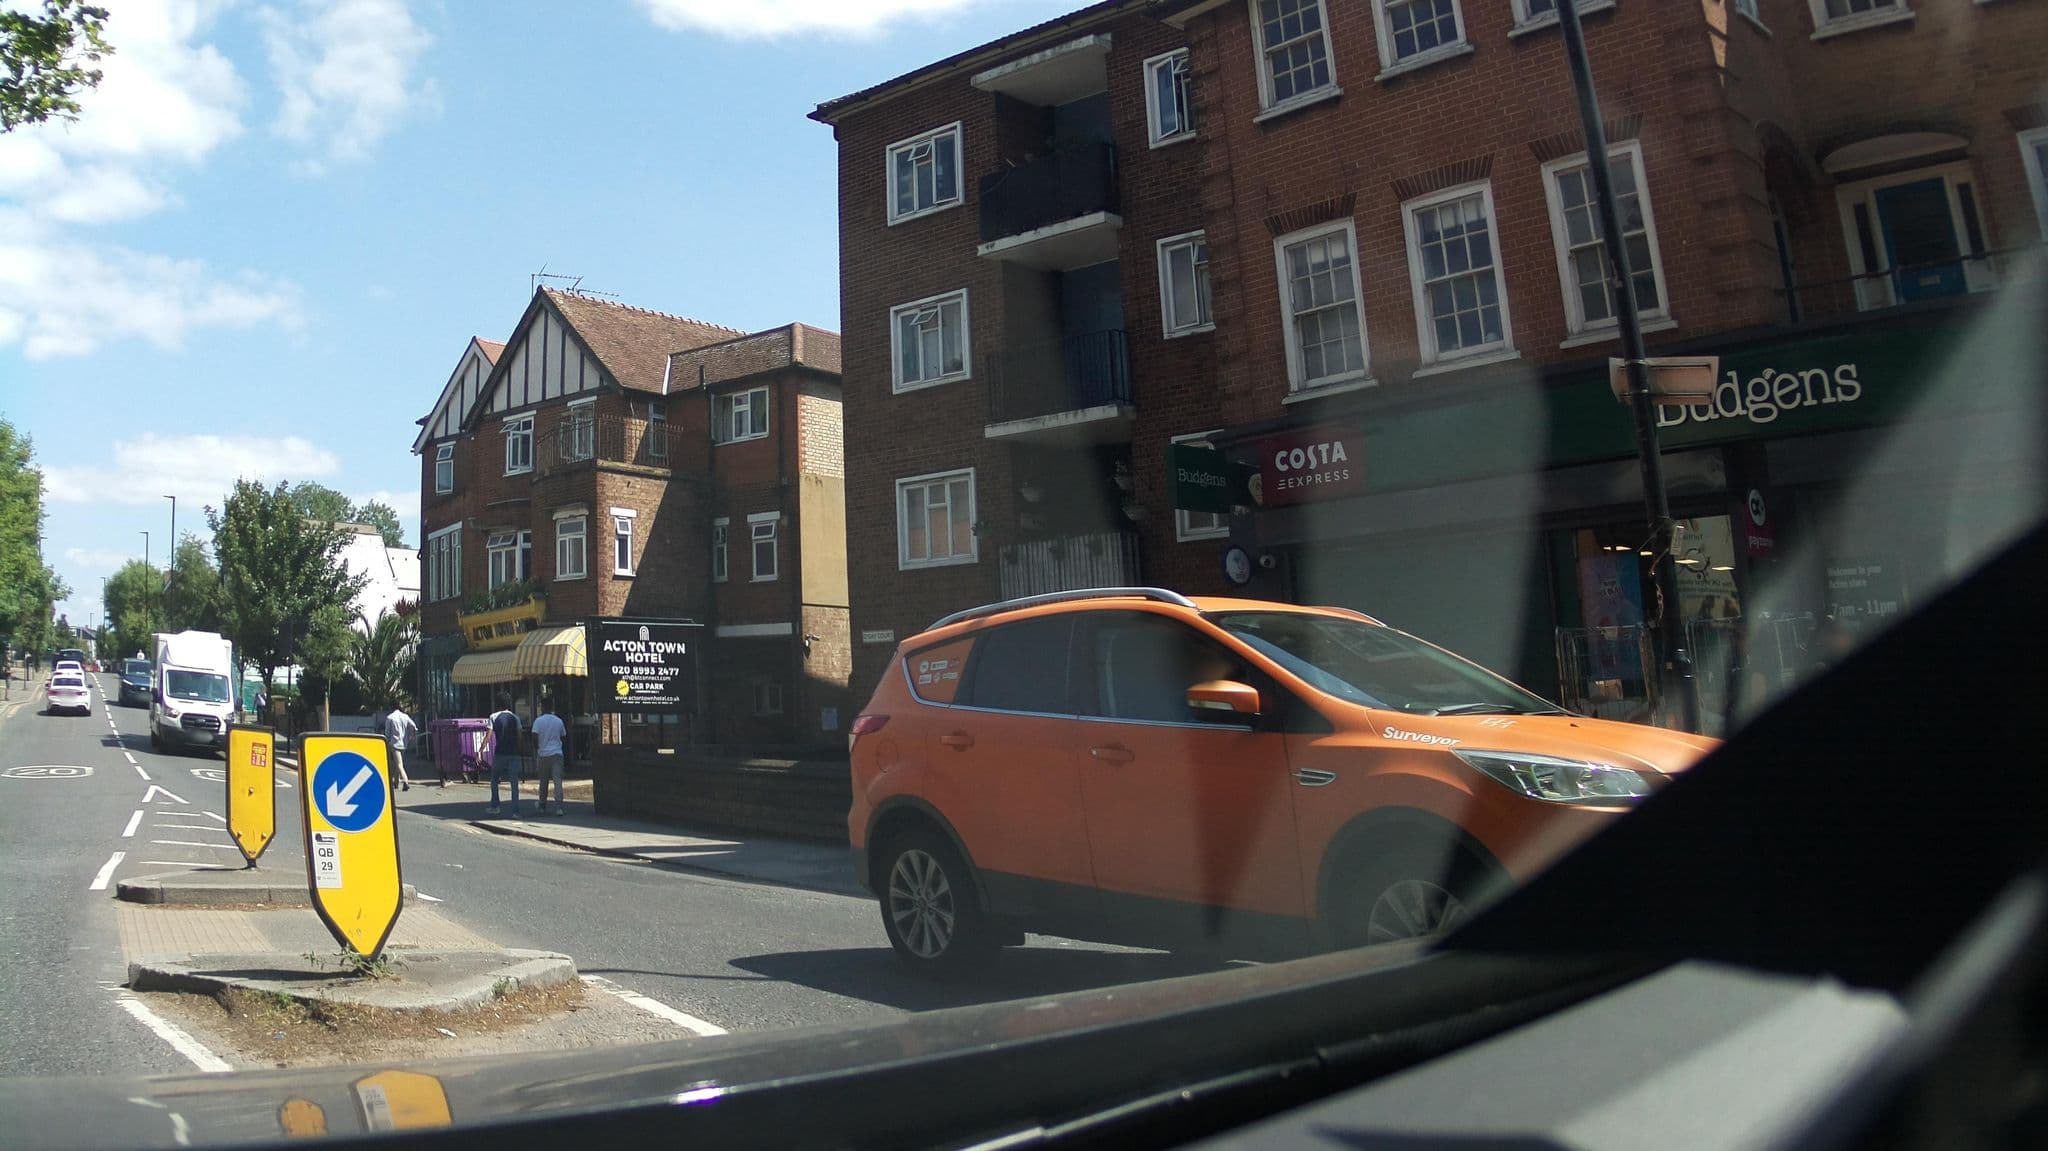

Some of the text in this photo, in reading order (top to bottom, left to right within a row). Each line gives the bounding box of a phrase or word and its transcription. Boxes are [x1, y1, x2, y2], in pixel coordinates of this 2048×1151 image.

[1275, 441, 1348, 472] COSTA
[1178, 467, 1226, 487] Budgens
[1288, 469, 1350, 488] EXPRESS
[1831, 603, 1856, 617] 7am
[1866, 599, 1897, 617] 11pm
[603, 640, 686, 654] ACTON TOWN
[625, 652, 665, 663] HOTEL
[611, 665, 679, 676] 020 8993 2477
[629, 682, 644, 690] CAR
[645, 682, 664, 690] PARK
[1383, 726, 1460, 747] Surveyor
[15, 768, 79, 776] 20
[318, 847, 334, 858] QB
[321, 861, 334, 871] 29
